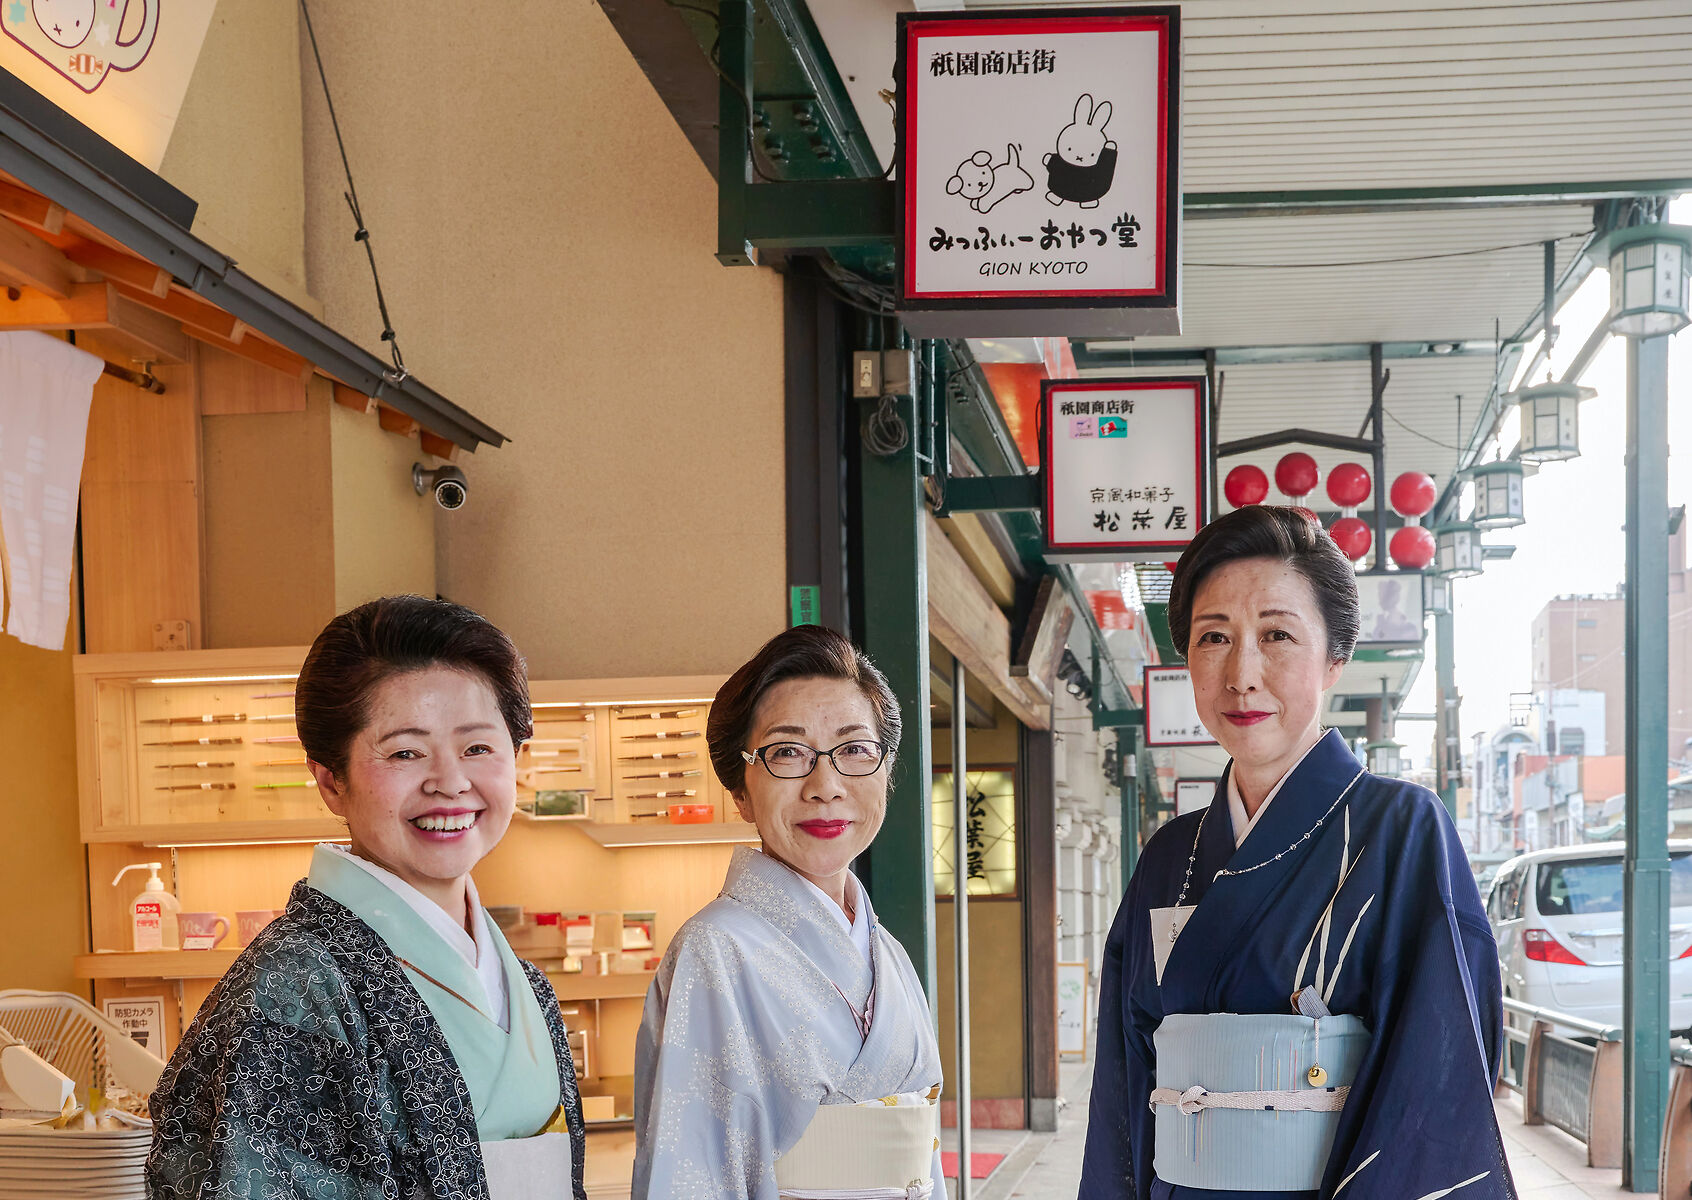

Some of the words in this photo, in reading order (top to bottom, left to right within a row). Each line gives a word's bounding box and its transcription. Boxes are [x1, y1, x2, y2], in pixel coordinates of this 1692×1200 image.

[929, 49, 1056, 77] 祇園商店街
[979, 262, 1021, 276] GION
[1029, 261, 1088, 275] KYOTO
[1060, 400, 1135, 416] 祇園商店街
[115, 1007, 154, 1018] 防犯カメラ
[122, 1019, 148, 1028] 作動中
